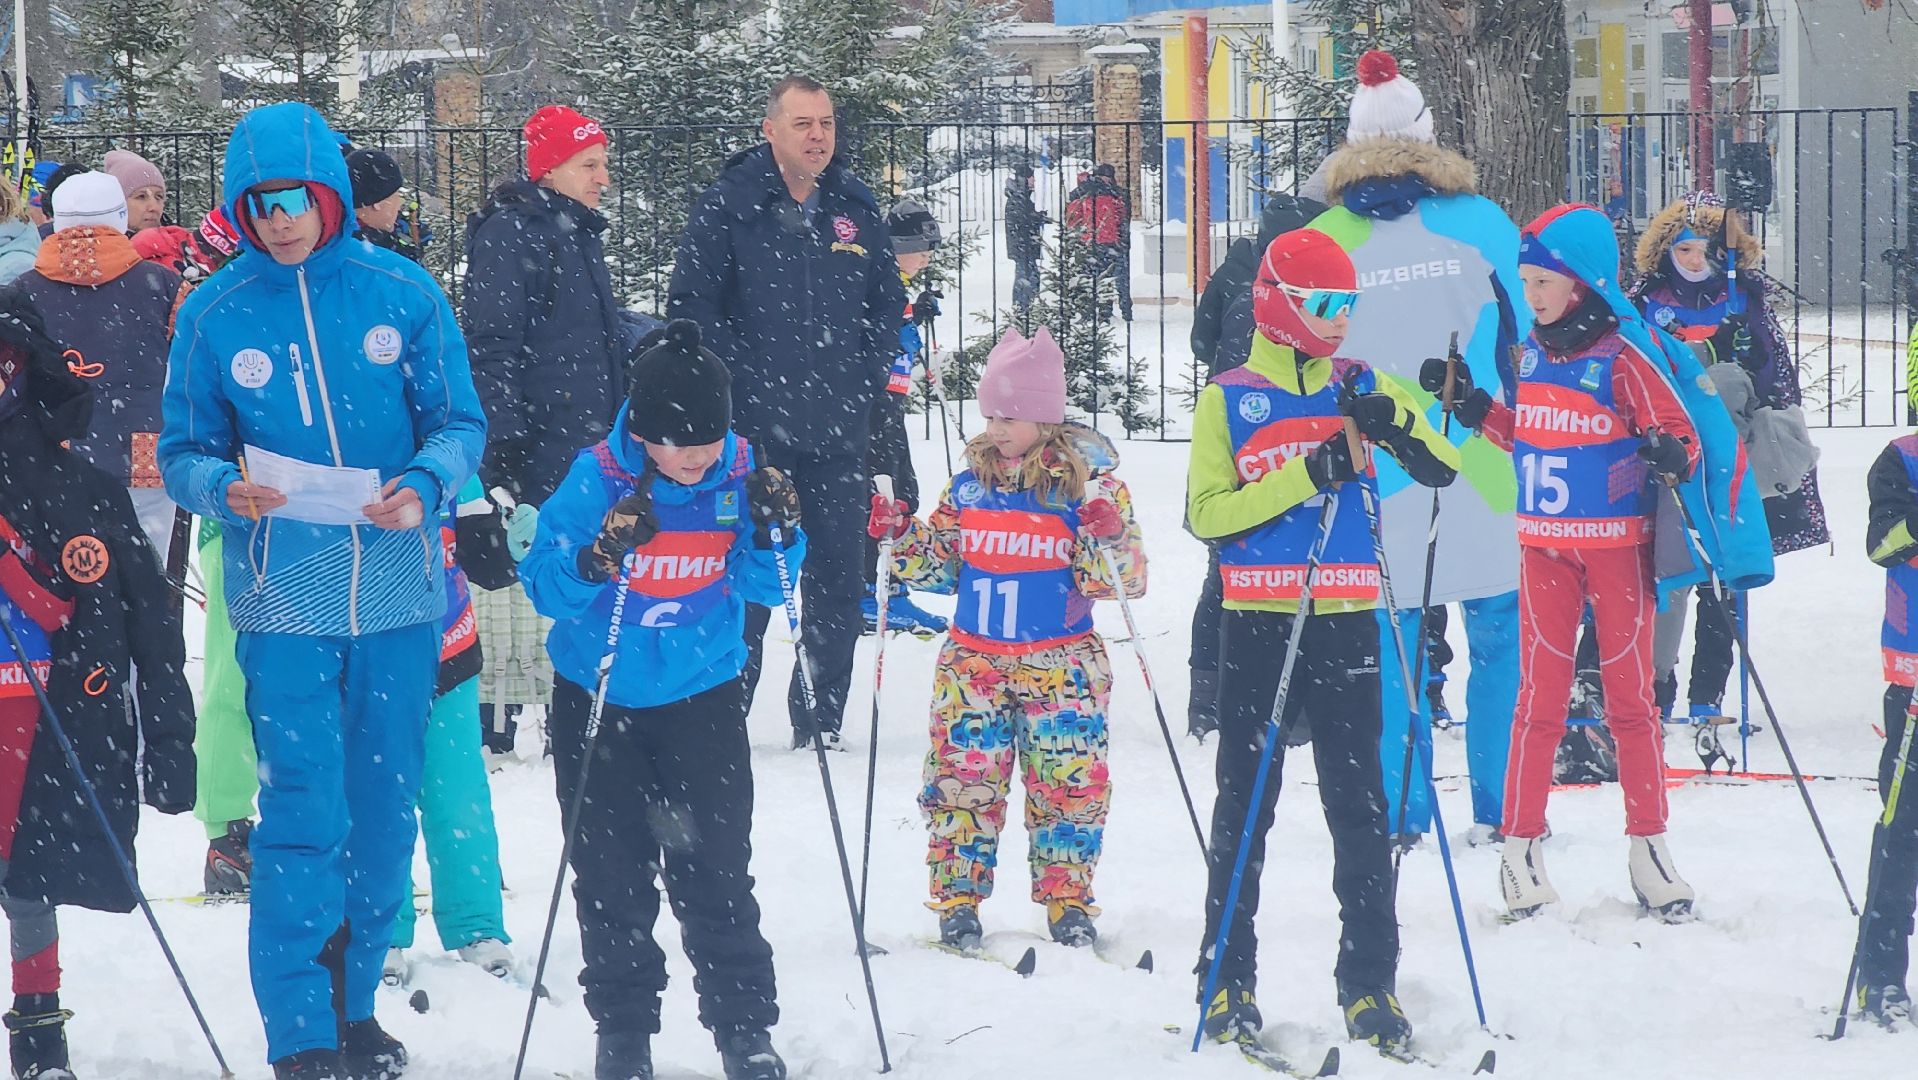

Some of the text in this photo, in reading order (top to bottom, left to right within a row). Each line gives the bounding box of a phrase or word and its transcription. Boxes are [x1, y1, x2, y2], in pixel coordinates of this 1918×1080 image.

[1360, 260, 1461, 288] UZBASS
[1515, 403, 1613, 436] ТУПИНО
[1522, 453, 1570, 515] 15
[960, 528, 1074, 562] ТУПИНО
[1517, 518, 1627, 538] PINOSKIRUN
[630, 553, 726, 580] УПИН
[774, 551, 798, 619] NORDWAY
[607, 575, 630, 646] NORDWAY
[972, 577, 1019, 639] 11
